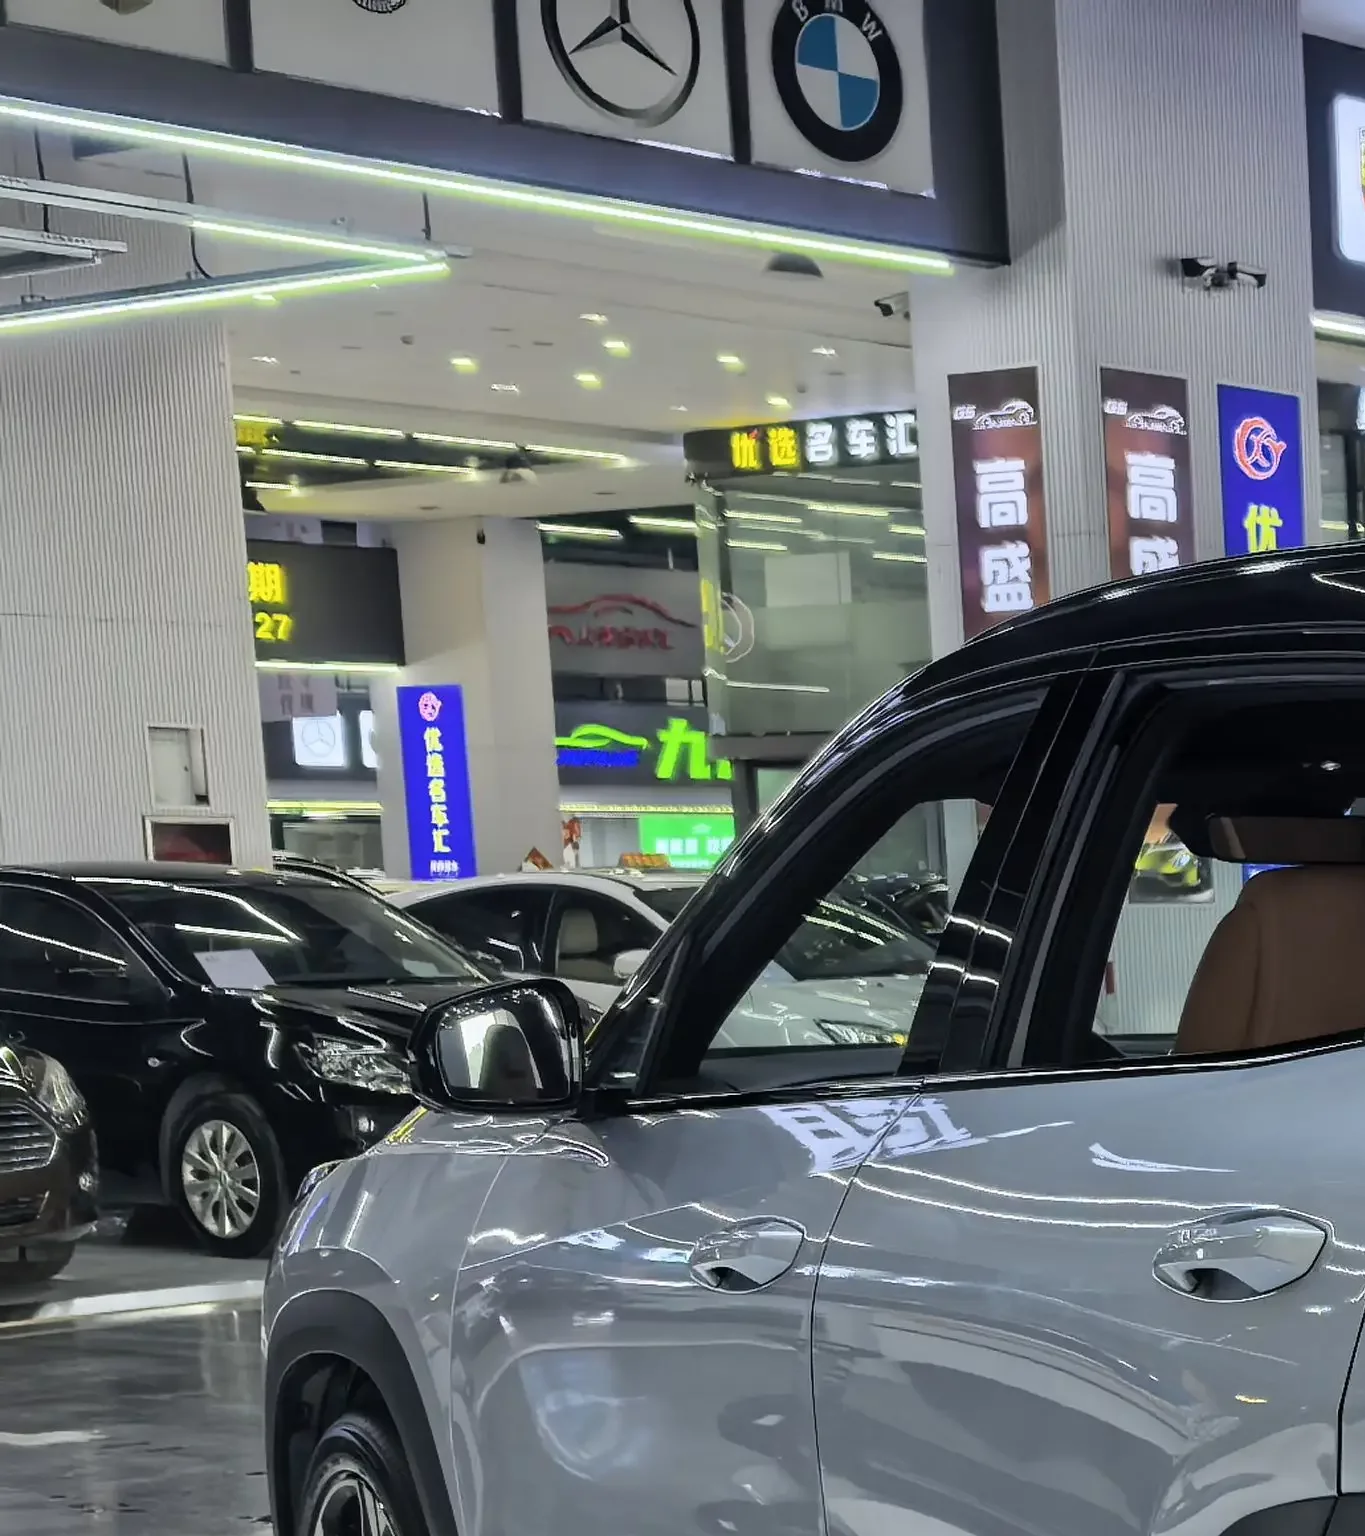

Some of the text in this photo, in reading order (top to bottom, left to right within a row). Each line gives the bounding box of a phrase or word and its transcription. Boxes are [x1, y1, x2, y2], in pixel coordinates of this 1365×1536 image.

[731, 413, 918, 472] 优选名车汇
[973, 457, 1034, 613] 高盛
[254, 611, 293, 641] 27
[423, 726, 452, 853] 优选名车汇
